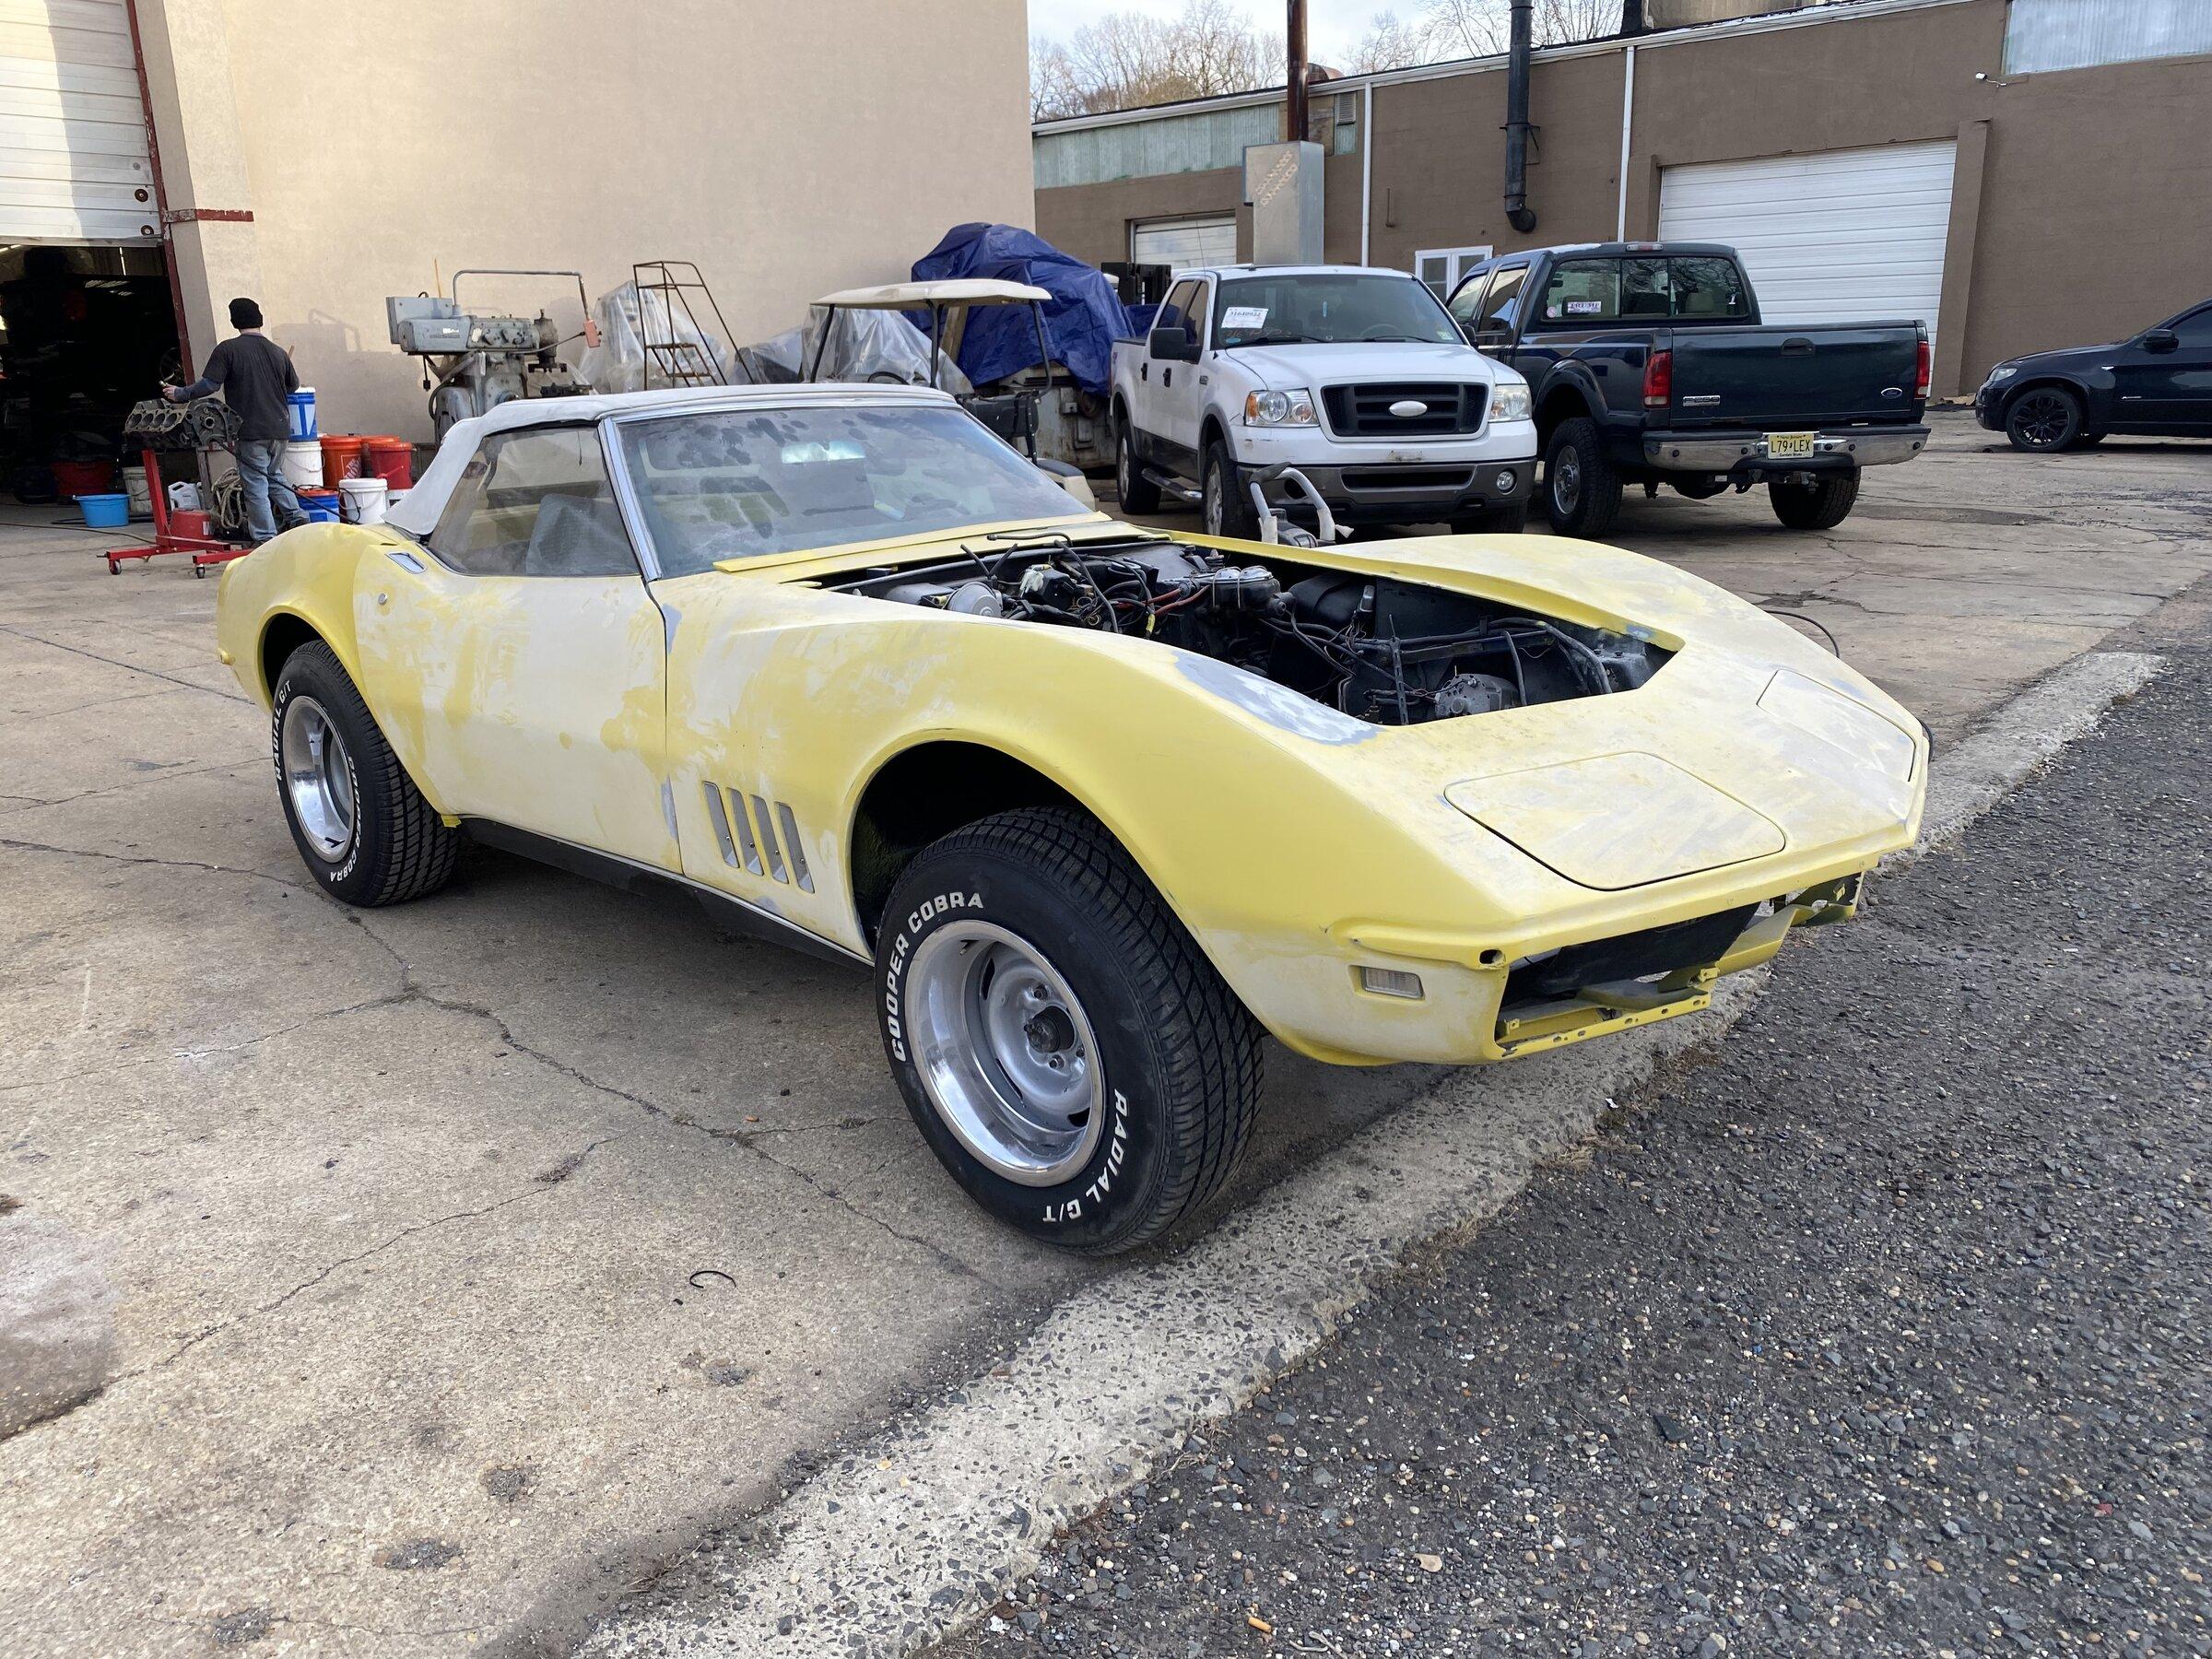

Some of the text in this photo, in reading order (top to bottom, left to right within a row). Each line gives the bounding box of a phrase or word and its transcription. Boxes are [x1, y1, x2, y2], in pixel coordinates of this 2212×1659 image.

[273, 680, 291, 781] RADIAL G/T
[330, 756, 360, 882] COOPER COBRA
[886, 891, 983, 1062] COOPER COBRA
[1042, 1088, 1128, 1222] RADIAL G/T
